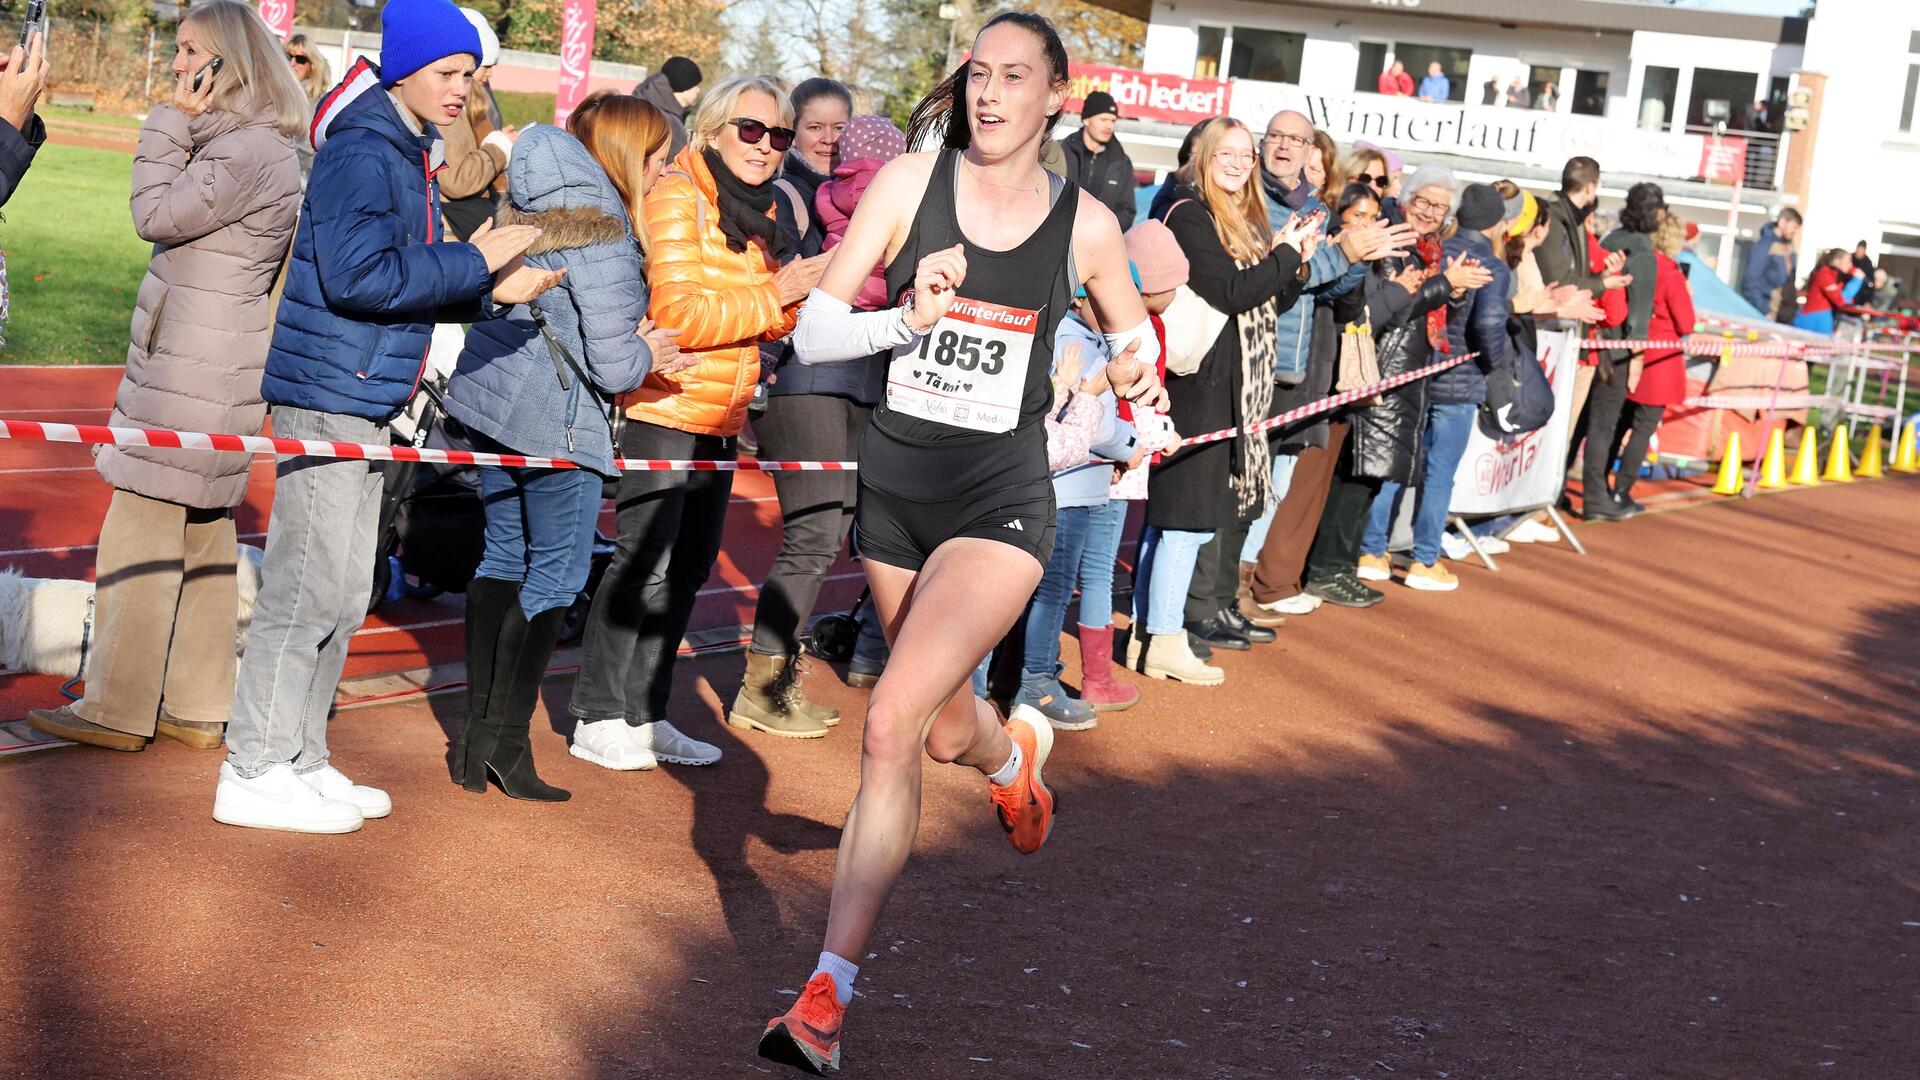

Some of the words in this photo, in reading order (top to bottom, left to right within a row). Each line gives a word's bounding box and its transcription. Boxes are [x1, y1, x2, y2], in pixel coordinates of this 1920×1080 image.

[1149, 78, 1225, 115] lecker!
[1305, 94, 1548, 152] Winterlauf
[948, 301, 1034, 327] Winterlauf
[918, 329, 1007, 376] 1853
[925, 371, 961, 393] Tämi
